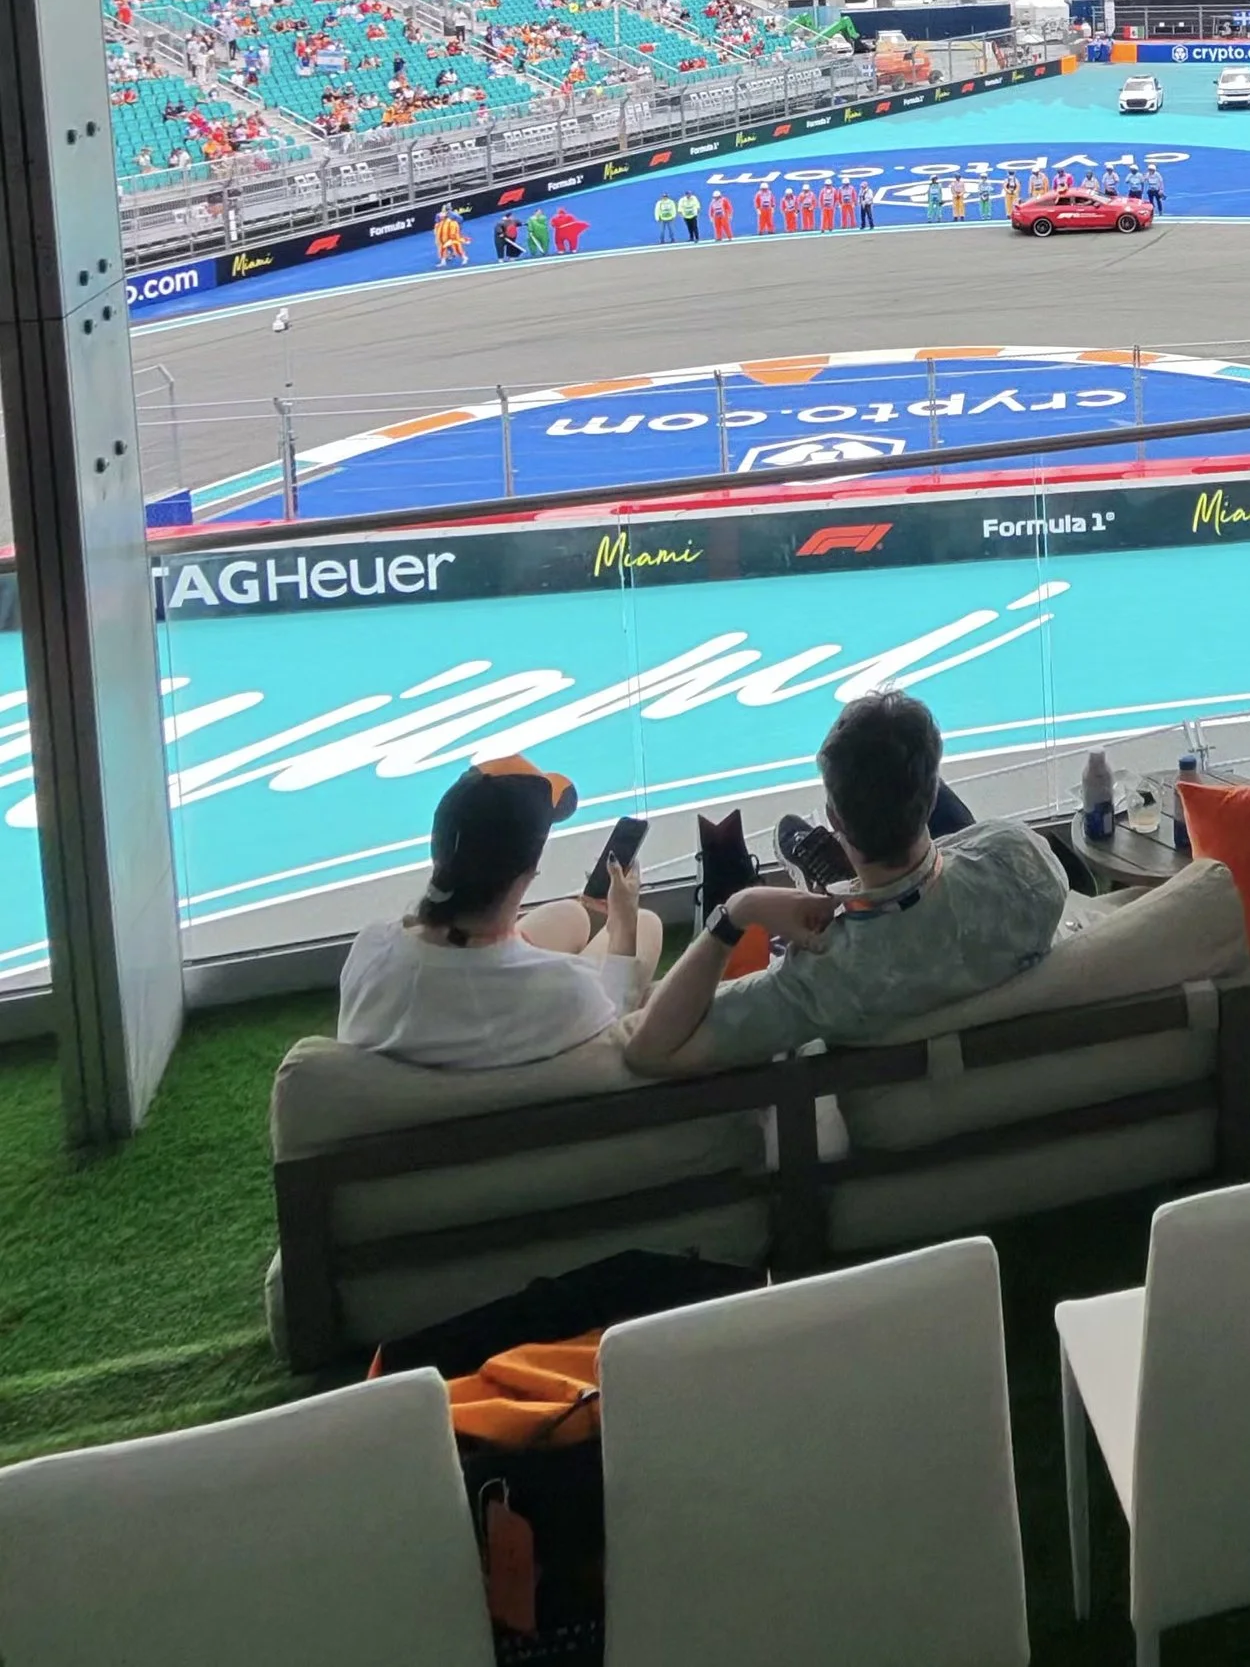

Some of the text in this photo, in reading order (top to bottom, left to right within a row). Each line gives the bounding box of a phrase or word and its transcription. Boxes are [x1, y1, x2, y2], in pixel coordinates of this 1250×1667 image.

[369, 221, 406, 238] Formula
[231, 252, 275, 277] Miami
[546, 388, 1127, 436] crypto.com
[982, 513, 1088, 539] Formula
[594, 531, 704, 578] Miami
